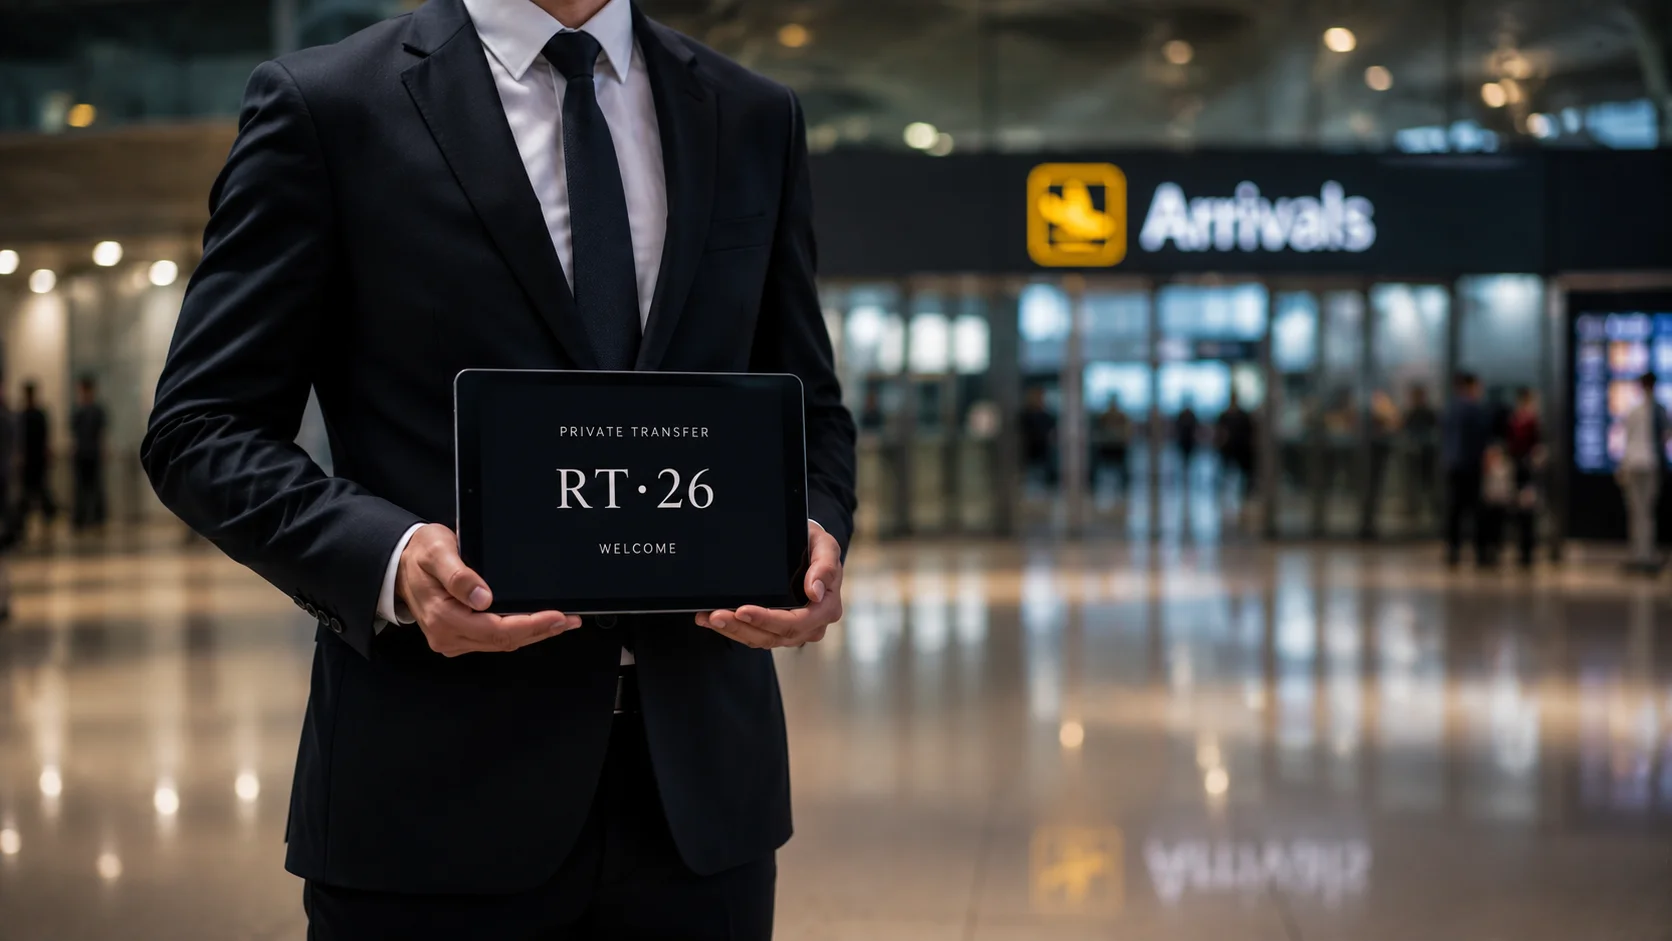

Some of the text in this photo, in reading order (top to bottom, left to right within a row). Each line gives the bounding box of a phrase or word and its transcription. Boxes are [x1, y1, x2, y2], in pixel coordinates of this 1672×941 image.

[1138, 180, 1377, 252] Arrivals
[560, 426, 710, 438] PRIVATE TRANSFER
[598, 542, 677, 555] WELCOME
